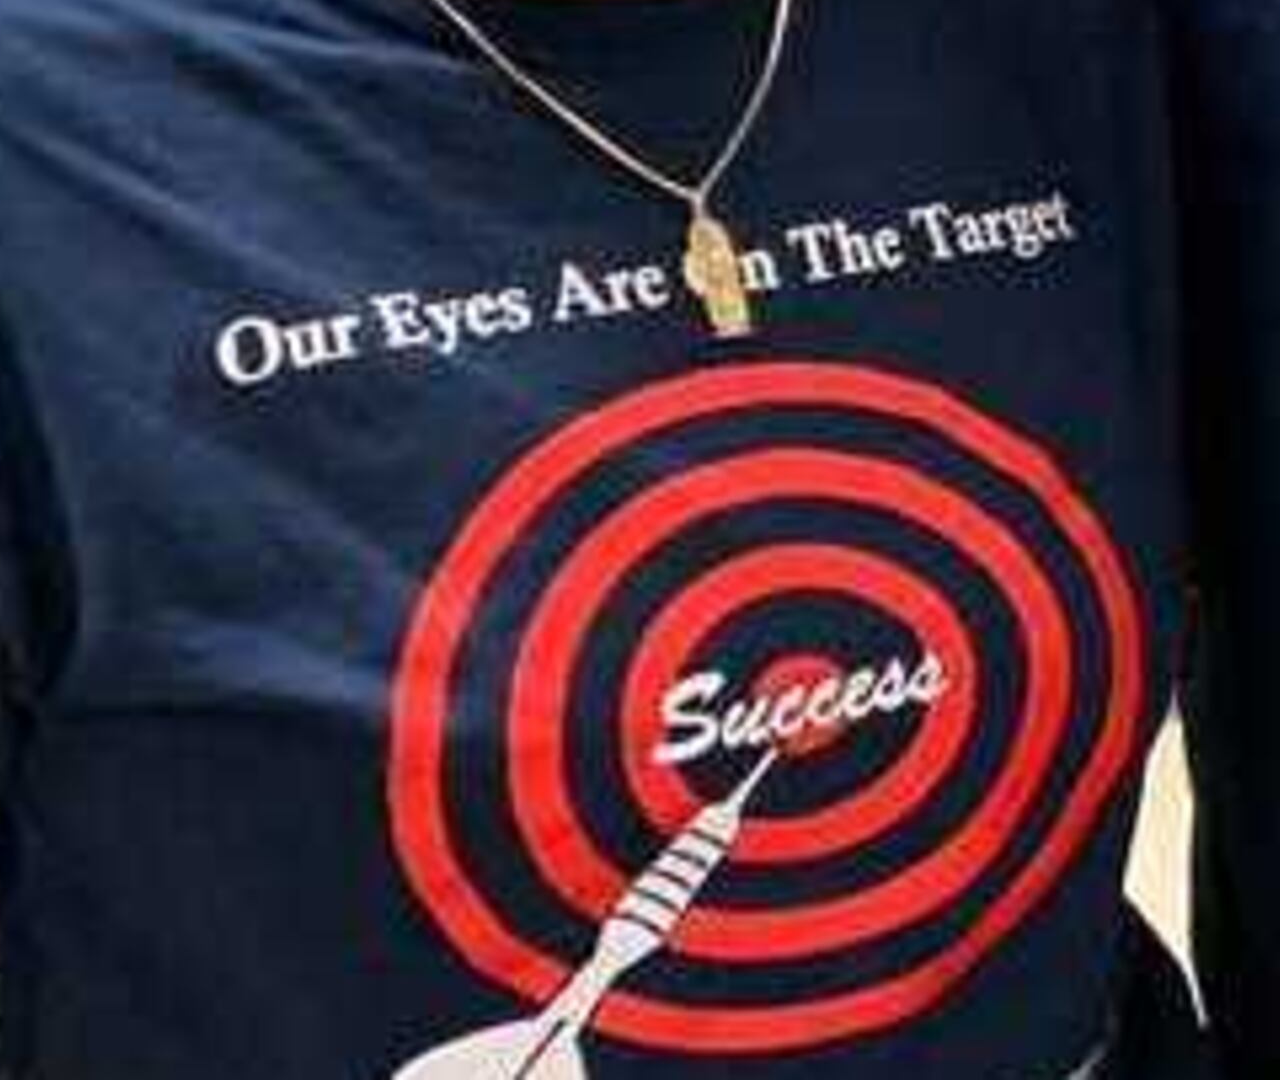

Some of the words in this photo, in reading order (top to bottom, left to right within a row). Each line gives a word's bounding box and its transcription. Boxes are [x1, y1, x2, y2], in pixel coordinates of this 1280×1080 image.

[216, 314, 361, 385] Our
[369, 288, 533, 360] Eyes
[553, 262, 670, 322] Are
[683, 248, 781, 298] n
[786, 218, 905, 282] The
[908, 193, 1073, 259] Target
[651, 650, 949, 765] Success
